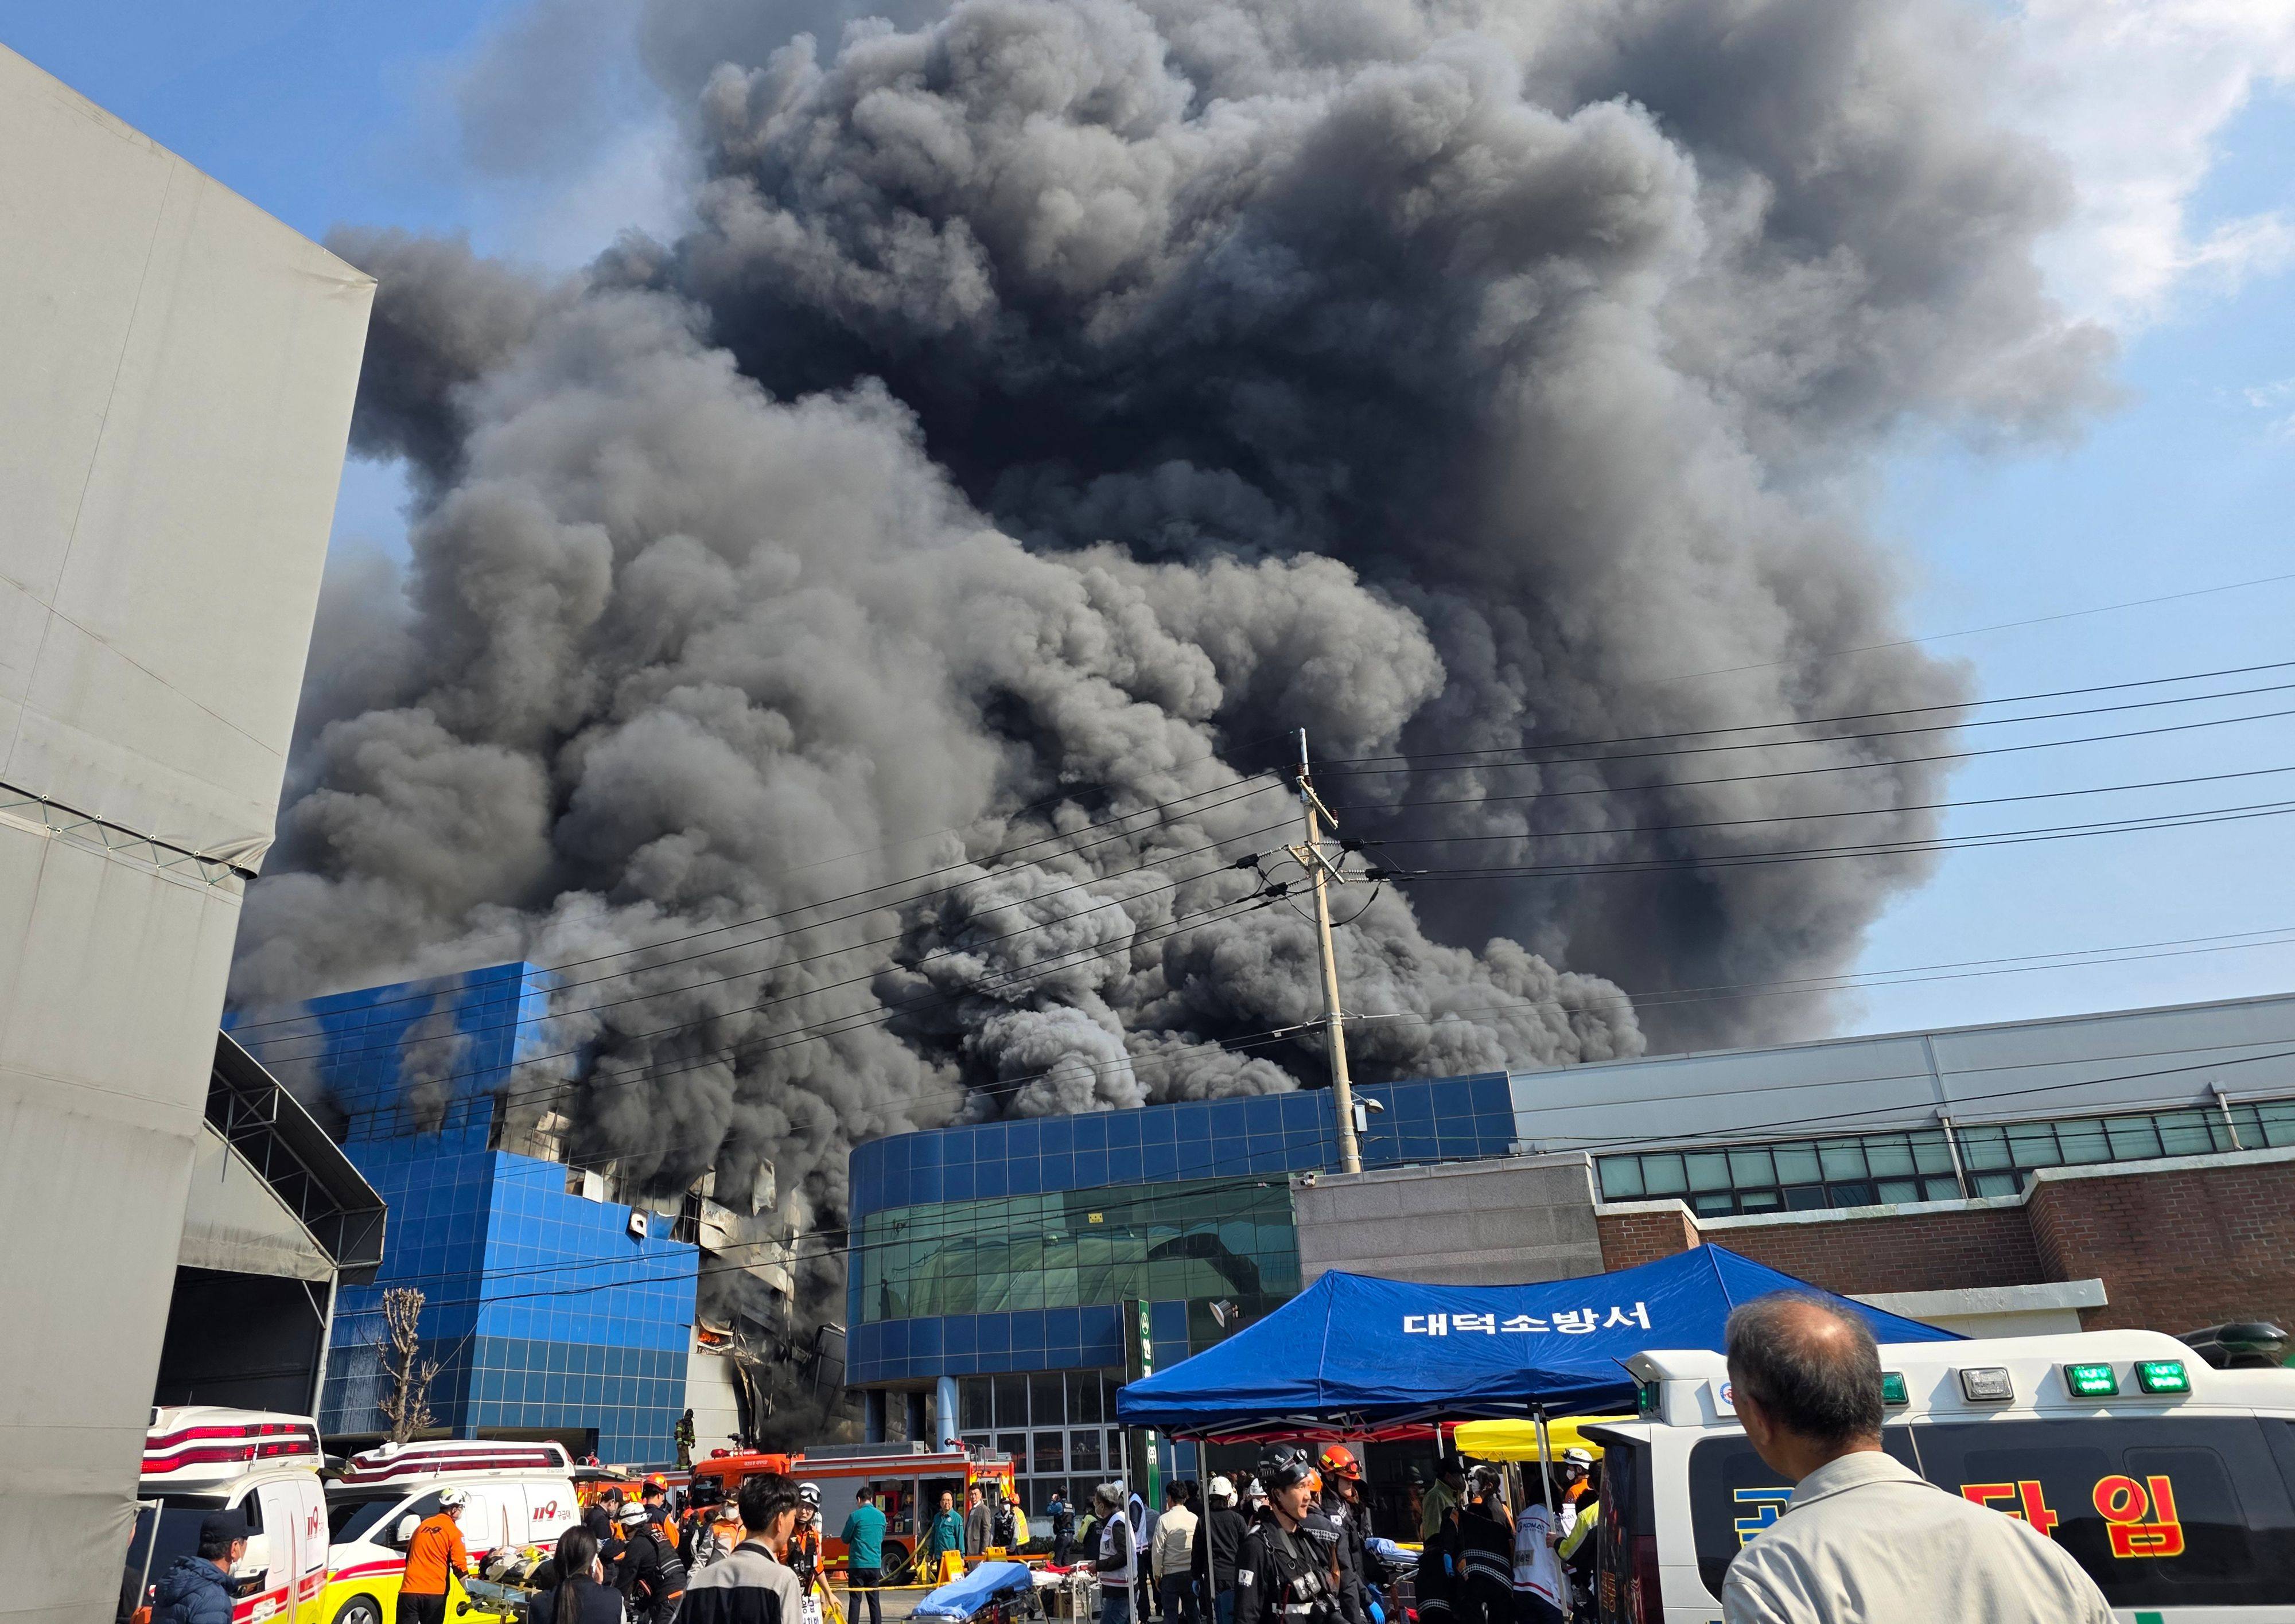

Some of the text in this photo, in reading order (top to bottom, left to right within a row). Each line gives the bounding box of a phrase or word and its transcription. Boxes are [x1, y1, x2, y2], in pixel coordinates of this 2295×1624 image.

[1403, 1302, 1651, 1335] 대덕소방서
[307, 1505, 319, 1540] 119
[532, 1500, 571, 1522] 119 구급대
